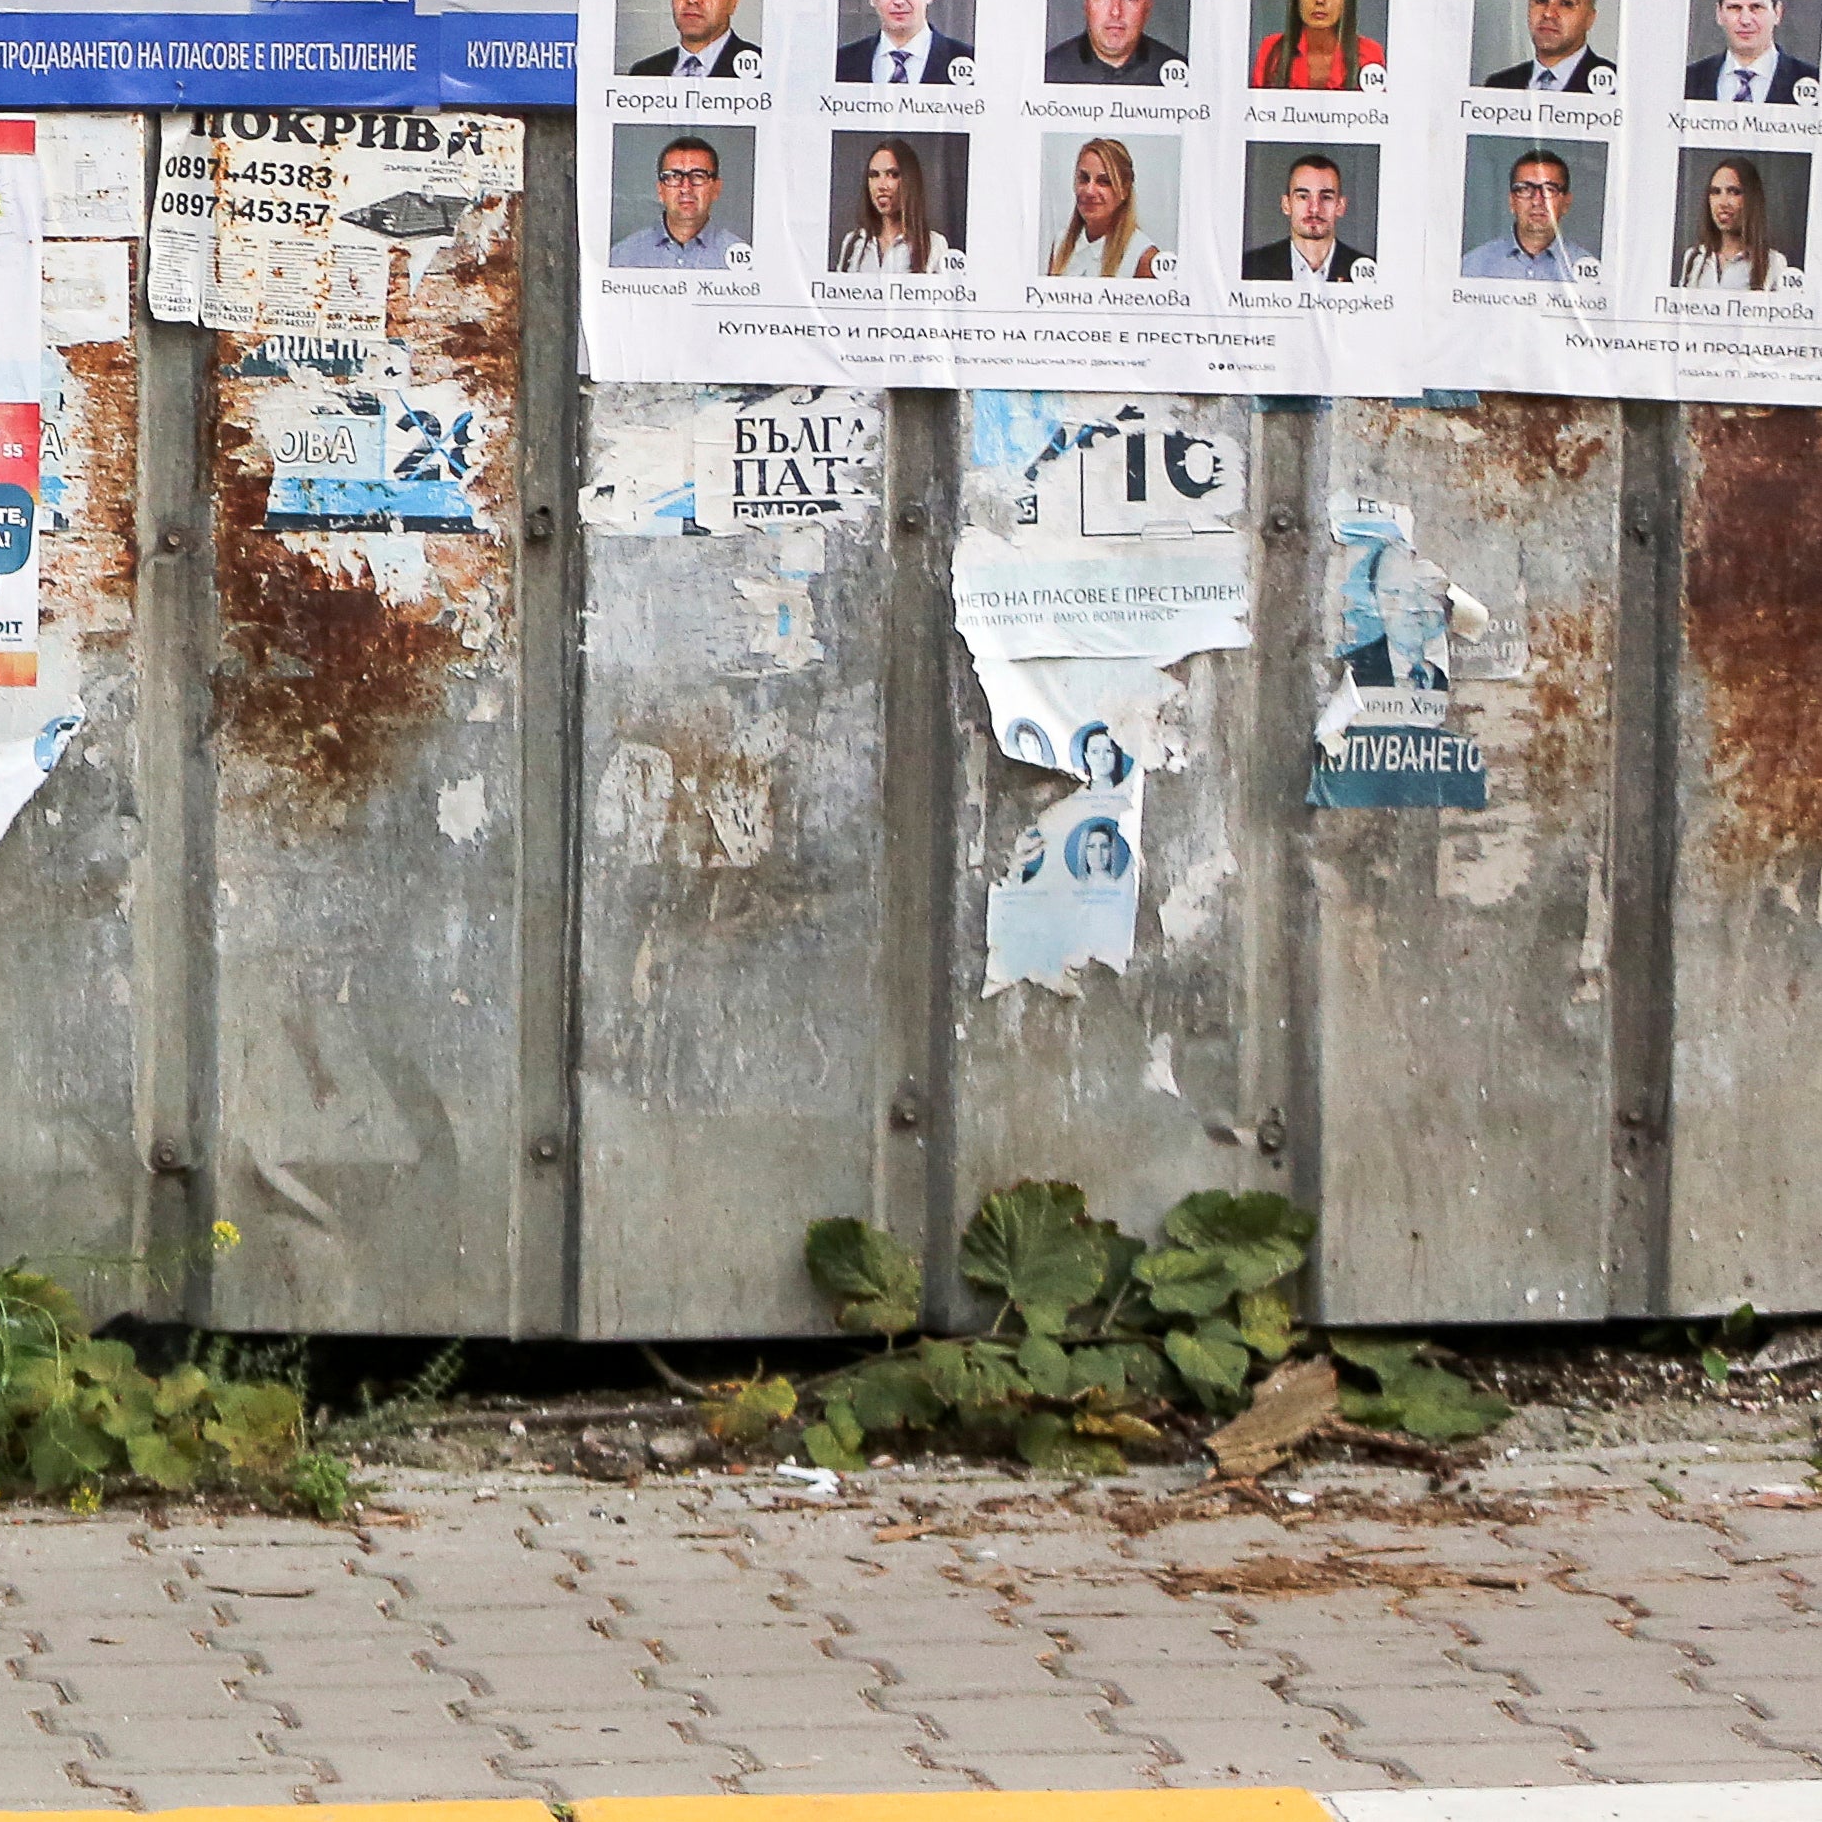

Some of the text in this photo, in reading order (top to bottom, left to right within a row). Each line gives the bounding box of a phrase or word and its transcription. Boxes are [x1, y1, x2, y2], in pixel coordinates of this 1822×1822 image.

[137, 42, 162, 69] НА
[168, 42, 250, 69] ГЛАСОВЕ
[254, 43, 264, 69] Е
[270, 43, 417, 72] ПРЕСТЪПЛЕНИЕ
[605, 90, 772, 114] Георги Петров
[820, 95, 985, 115] Христо Михалчев
[1020, 100, 1211, 122] Любомир Димитров
[1244, 107, 1389, 127] Ася Димитрова
[601, 280, 760, 297] Венцислав Жилков
[811, 281, 976, 305] Памела Петрова
[1026, 288, 1190, 307] Румяна Ангелова
[1229, 292, 1394, 313] Митко Джорджев
[1004, 586, 1027, 607] НА
[1033, 583, 1107, 606] ГЛАСОВЕ
[1110, 587, 1120, 604] Е
